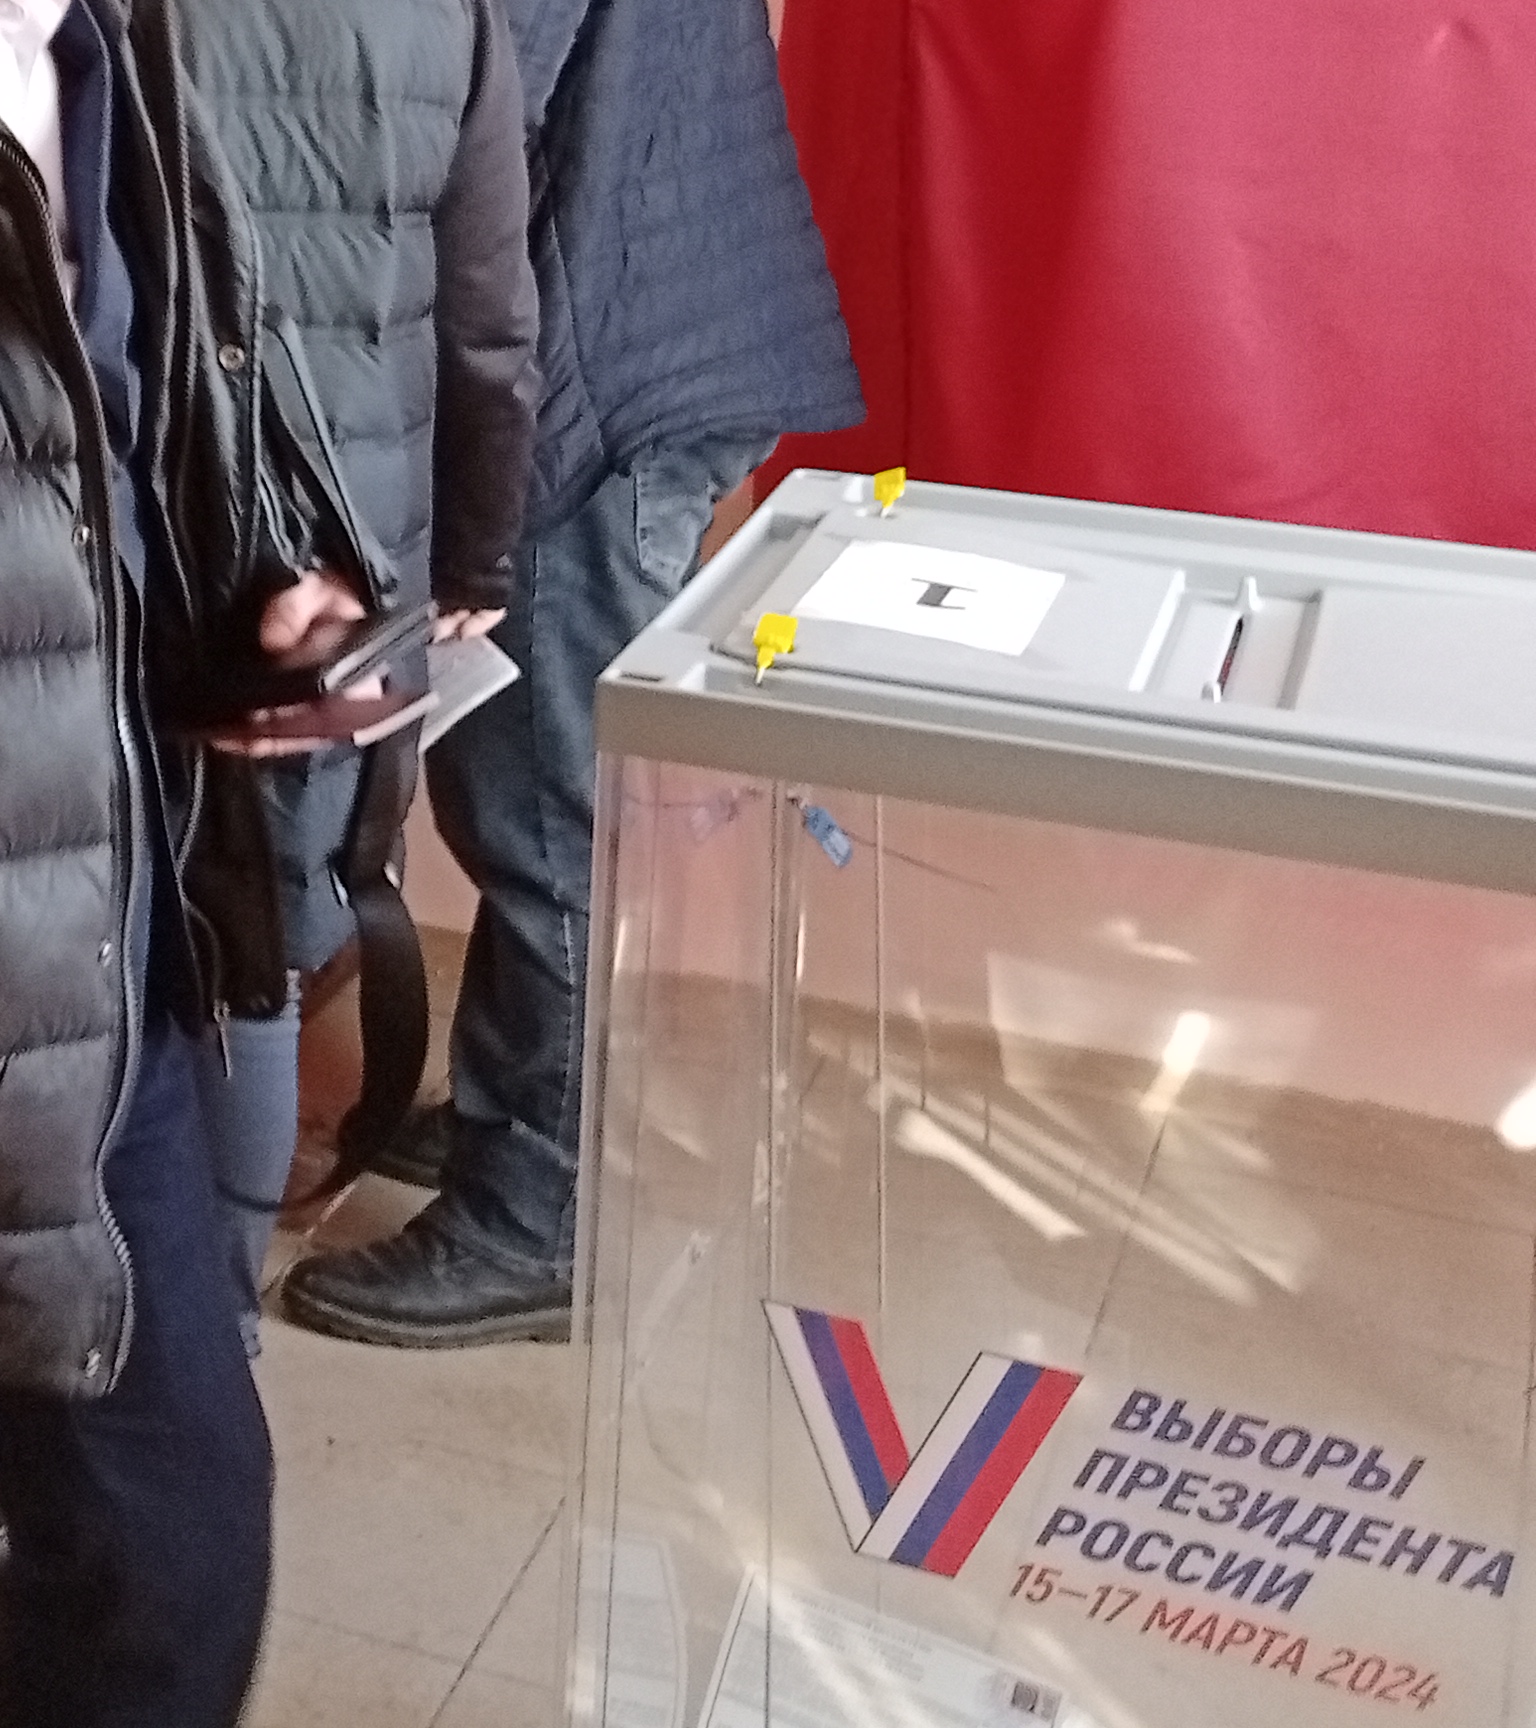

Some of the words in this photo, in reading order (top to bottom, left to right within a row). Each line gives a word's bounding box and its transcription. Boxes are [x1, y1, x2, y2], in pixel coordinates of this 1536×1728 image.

[1110, 1387, 1425, 1502] ВЫБОРЫ
[1034, 1506, 1315, 1614] РОССИИ
[1070, 1447, 1518, 1598] ПРЕЗИДЕНТА
[1141, 1598, 1310, 1677] МАРТА
[1313, 1646, 1443, 1712] 2024
